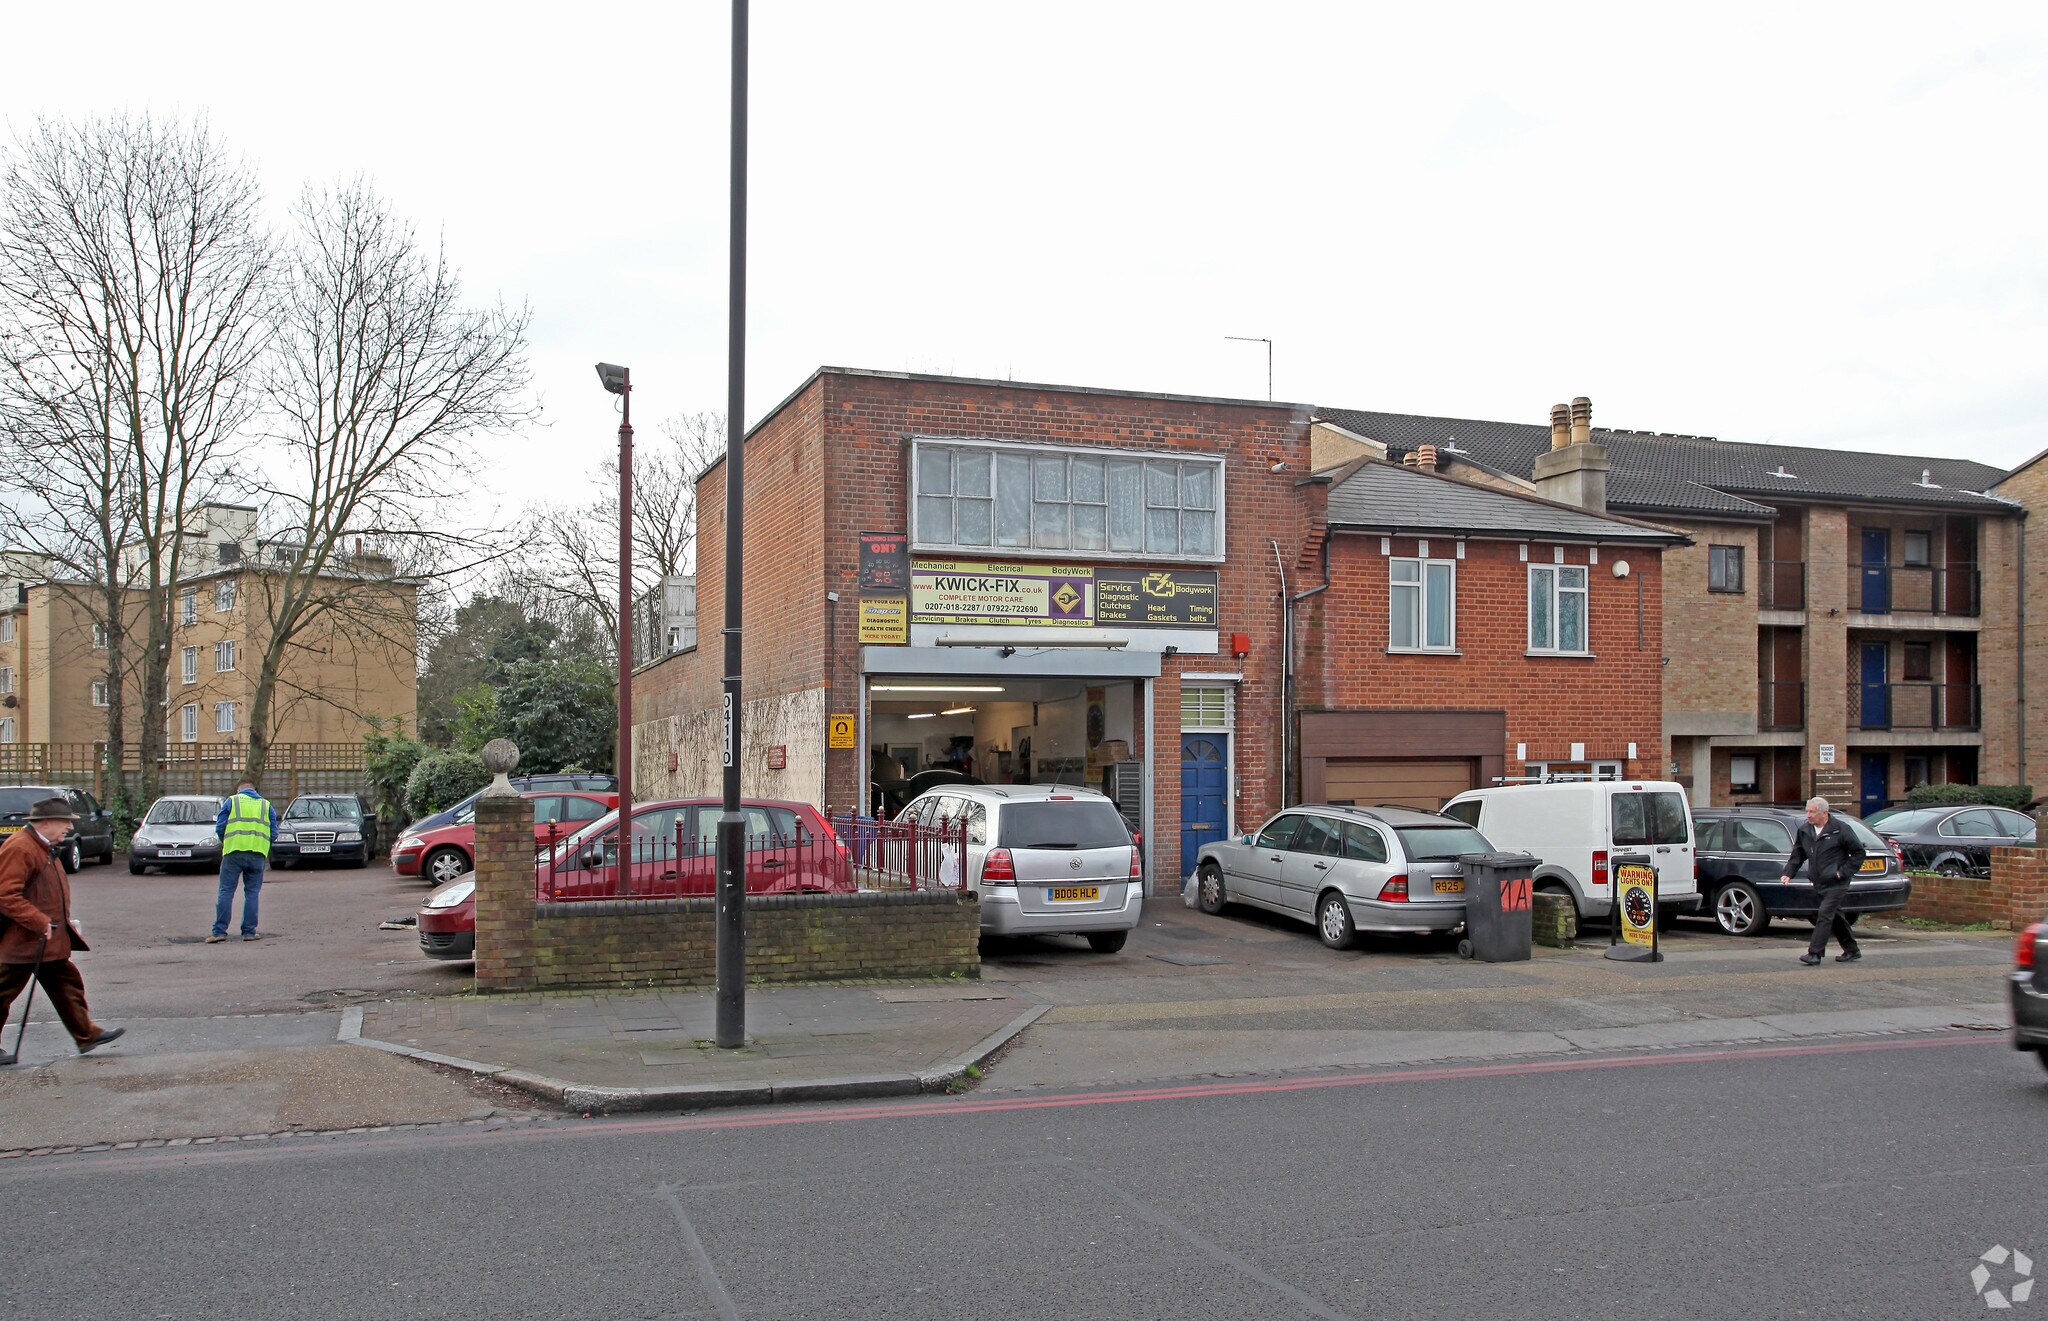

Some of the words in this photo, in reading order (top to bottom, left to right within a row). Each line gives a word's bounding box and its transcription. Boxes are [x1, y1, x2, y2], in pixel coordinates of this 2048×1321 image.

[871, 543, 896, 553] ON?
[912, 562, 956, 570] Mechanical
[987, 564, 1024, 572] Electrical
[1052, 567, 1091, 575] BodyWork
[1100, 583, 1132, 592] Service
[1176, 586, 1212, 594] Bodywork
[1100, 593, 1139, 601] Diagnostic
[924, 603, 980, 611] 0207-018-2287
[987, 605, 1038, 613] 07922-722690
[1100, 602, 1131, 610] Clutches
[1147, 604, 1166, 612] Head
[1189, 605, 1213, 614] Timing
[1100, 611, 1127, 619] Brakes
[1147, 613, 1178, 622] Gaskets
[913, 615, 945, 623] Servicing
[1052, 618, 1089, 626] Diagnostics
[1620, 869, 1653, 880] WARNING
[1435, 881, 1459, 891] R925
[1620, 878, 1640, 886] LIGHTS
[1641, 879, 1653, 887] ON?
[1054, 889, 1078, 898] BD06
[1080, 888, 1098, 898] HLP
